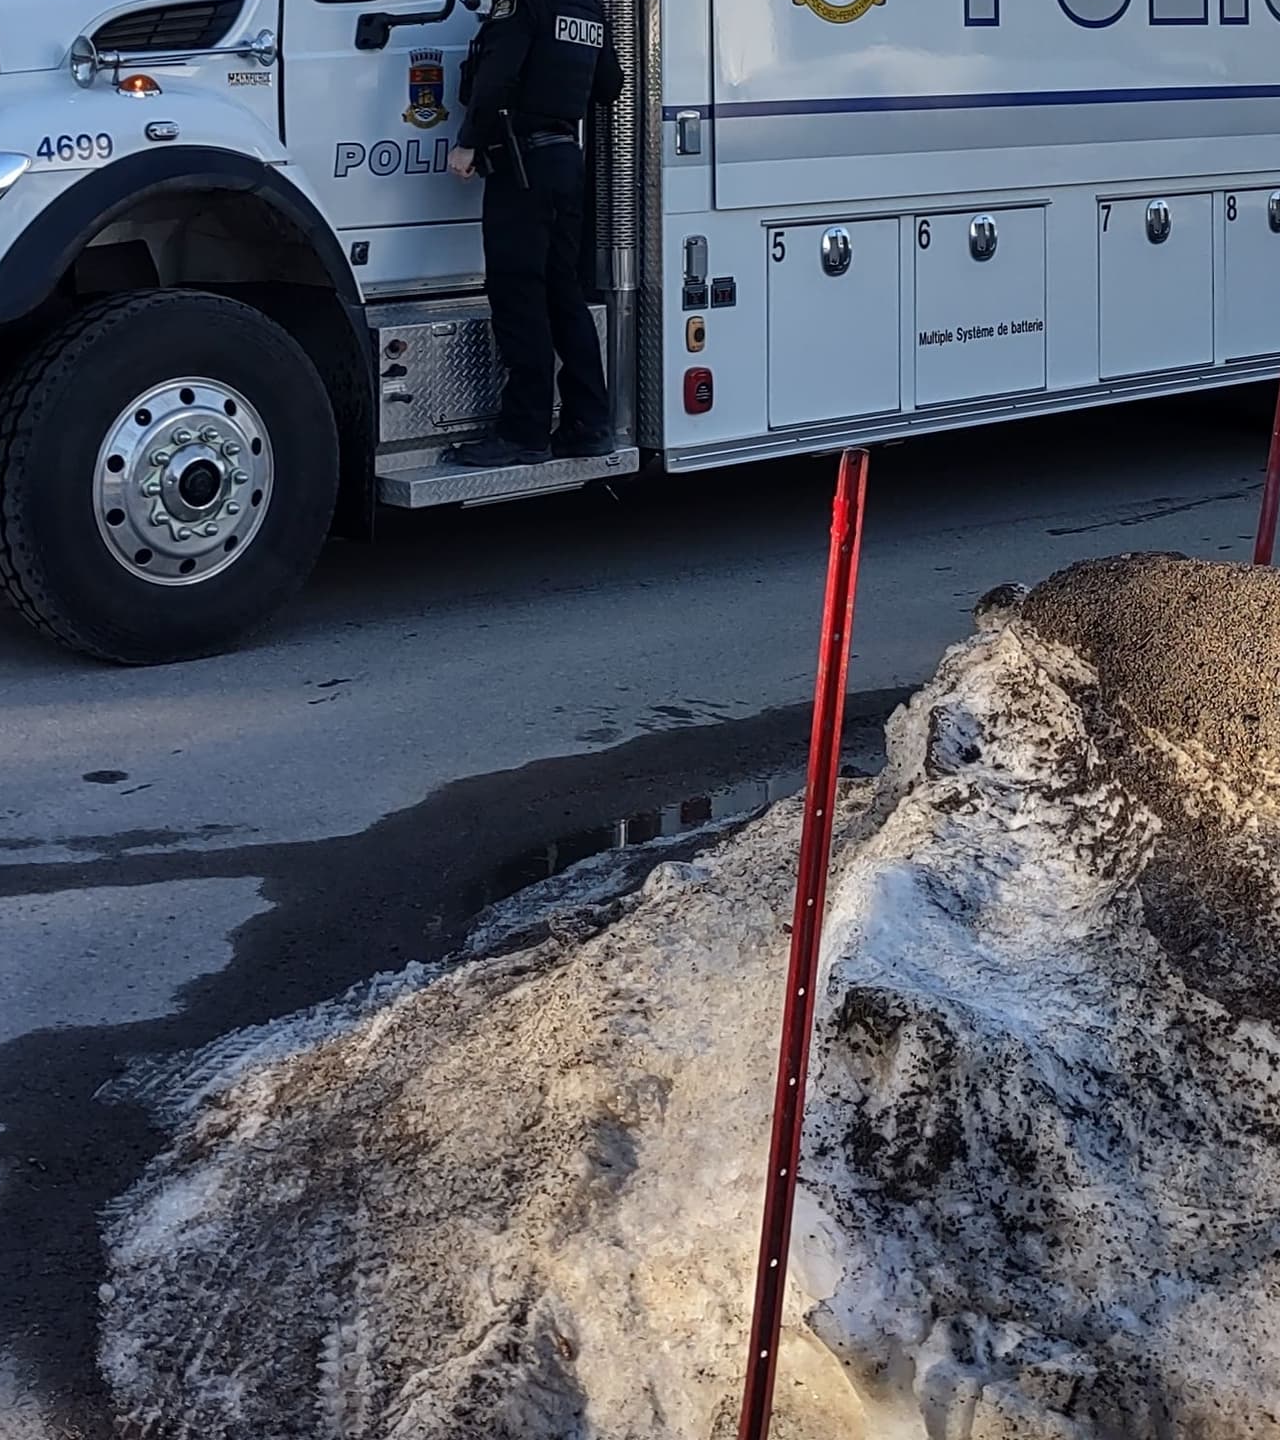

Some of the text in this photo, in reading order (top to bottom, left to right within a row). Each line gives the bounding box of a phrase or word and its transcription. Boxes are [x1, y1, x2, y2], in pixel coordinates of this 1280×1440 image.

[558, 18, 603, 46] POLICE
[36, 133, 113, 162] 4699
[334, 138, 449, 178] POLI
[1101, 204, 1112, 232] 7
[1227, 195, 1237, 222] 8
[772, 231, 785, 263] 5
[918, 219, 930, 250] 6
[919, 329, 953, 346] Multiple
[997, 323, 1008, 336] de
[1011, 318, 1043, 334] batterie
